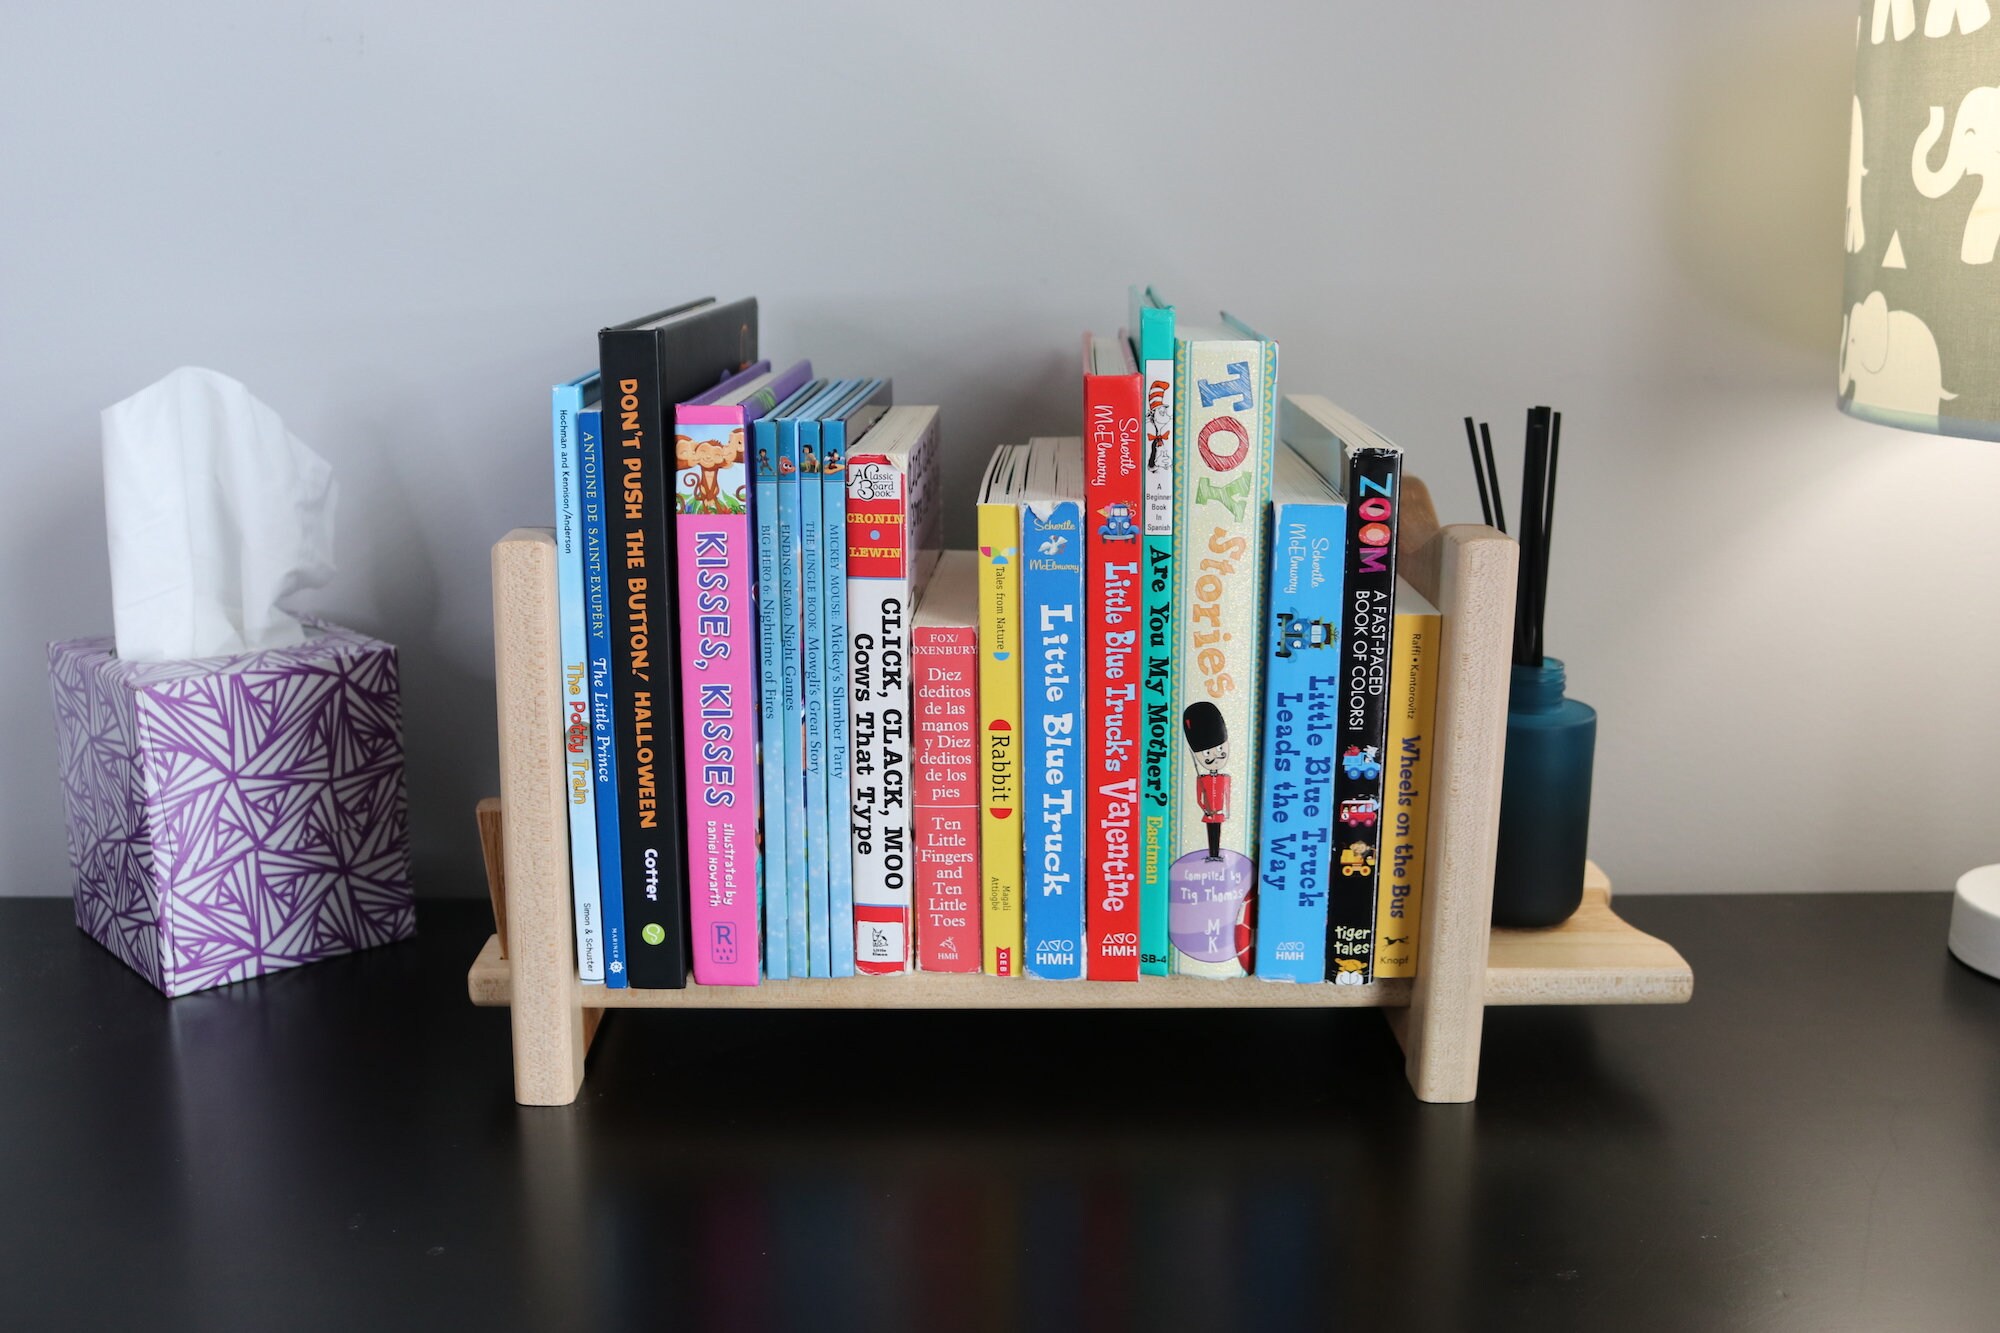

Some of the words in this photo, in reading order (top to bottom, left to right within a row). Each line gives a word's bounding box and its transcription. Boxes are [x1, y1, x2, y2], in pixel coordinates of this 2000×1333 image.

[619, 378, 641, 449] DON'T
[1091, 405, 1115, 487] McElmurry
[1118, 417, 1139, 477] Schertle
[1195, 361, 1253, 523] TOY
[583, 431, 596, 498] ANTOINE
[846, 469, 863, 487] A
[864, 464, 893, 480] Classic
[622, 457, 643, 520] PUSH
[1146, 493, 1172, 502] Beginner
[562, 470, 572, 554] Kennison/Anderson
[587, 504, 597, 522] DE
[847, 514, 904, 524] CRONIN
[1033, 519, 1076, 531] Schertle
[1147, 524, 1171, 532] Spanish
[1358, 473, 1393, 574] ZOOM
[625, 528, 645, 569] THE
[761, 525, 770, 545] BIG
[806, 521, 814, 545] THE
[830, 524, 839, 570] MICKEY
[762, 550, 771, 581] HERO
[781, 524, 791, 581] FINDING
[849, 547, 901, 558] LEWIN
[1029, 560, 1079, 573] McElmurry
[1150, 546, 1172, 592] Are
[1283, 523, 1307, 594] McElmurry
[1311, 538, 1330, 588] Schertle
[588, 528, 604, 638] SAINT-EXUPÉRY
[763, 584, 771, 595] 6:
[806, 549, 816, 594] JUNGLE
[996, 566, 1005, 590] Tales
[694, 531, 731, 670] KISSES,
[783, 583, 792, 620] NEMO:
[831, 574, 840, 619] MOUSE:
[996, 593, 1005, 614] from
[1105, 562, 1138, 624] Little
[1373, 590, 1388, 602] A
[627, 577, 650, 682] BUTTON!
[808, 596, 817, 631] BOOK:
[1149, 602, 1170, 648] You
[1192, 526, 1248, 700] Stories
[1354, 591, 1370, 636] BOOK
[760, 599, 775, 666] Nighttime
[782, 624, 795, 661] Night
[877, 598, 902, 698] CLICK,
[930, 634, 958, 643] FOX/
[996, 617, 1005, 650] Nature
[1353, 640, 1368, 661] OF
[1368, 606, 1387, 695] FAST-PACED
[1411, 633, 1422, 656] Raffi
[805, 636, 820, 696] Mowgli's
[828, 624, 844, 682] Mickey's
[854, 633, 874, 701] Cows
[1040, 604, 1073, 702] Little
[1105, 630, 1136, 679] Blue
[567, 662, 585, 695] The
[593, 658, 606, 686] The
[766, 669, 777, 685] of
[784, 665, 796, 711] Games
[928, 668, 962, 681] Diez
[1145, 656, 1169, 696] My
[765, 686, 777, 719] Fires
[919, 685, 970, 698] deditos
[925, 702, 942, 715] de
[947, 702, 965, 715] las
[1349, 666, 1367, 730] COLORS!
[1407, 665, 1420, 719] Kantorovitz
[567, 701, 589, 753] Potty
[594, 690, 609, 731] Little
[810, 700, 821, 735] Great
[833, 686, 845, 740] Slumber
[922, 721, 968, 731] manos
[1105, 683, 1136, 772] Truck's
[1306, 675, 1335, 746] Little
[700, 684, 735, 807] KISSES
[856, 711, 875, 776] That
[925, 738, 934, 750] y
[937, 735, 971, 748] Diez
[1043, 712, 1073, 785] Blue
[1274, 692, 1303, 772] Leads
[597, 735, 610, 782] Prince
[634, 691, 657, 829] HALLOWEEN
[807, 739, 822, 775] Story
[831, 744, 845, 779] Party
[878, 708, 903, 816] CLACK,
[920, 751, 971, 765] deditos
[991, 735, 1011, 802] Rabbit
[1145, 702, 1169, 807] Mother?
[1398, 735, 1421, 807] Wheels
[571, 758, 590, 805] Train
[925, 769, 942, 781] de
[947, 769, 967, 781] los
[932, 786, 960, 799] pies
[1303, 756, 1331, 817] Blue
[852, 786, 876, 855] Type
[1272, 781, 1298, 823] the
[928, 833, 966, 847] Little
[932, 817, 961, 830] Ten
[1396, 812, 1411, 838] on
[884, 826, 904, 889] MOO
[921, 850, 974, 865] Fingers
[1043, 789, 1073, 897] Truck
[1099, 778, 1137, 912] Valentine
[1145, 816, 1163, 884] Eastman
[1392, 842, 1414, 879] the
[644, 848, 658, 901] Cotter
[936, 866, 963, 879] and
[1184, 869, 1225, 886] Compiled
[1230, 870, 1242, 884] by
[1262, 833, 1297, 891] Way
[1298, 827, 1327, 907] Truck
[723, 891, 736, 906] by
[929, 898, 967, 911] Little
[932, 882, 962, 895] Ten
[991, 876, 999, 911] Attiogbé
[1001, 885, 1011, 912] Magali
[1180, 887, 1198, 905] Tig
[1205, 886, 1244, 903] Thomas
[1390, 885, 1411, 919] Bus
[583, 902, 591, 926] Simon
[930, 914, 966, 927] Toes
[611, 927, 619, 959] MARINER
[1102, 946, 1136, 957] HMH
[1334, 926, 1371, 942] tiger
[1334, 942, 1370, 955] tales
[586, 938, 594, 972] Schuster
[1036, 953, 1074, 965] HMH
[1141, 954, 1167, 964] SB-4
[1276, 951, 1304, 961] HMH
[1380, 956, 1409, 965] Knopf
